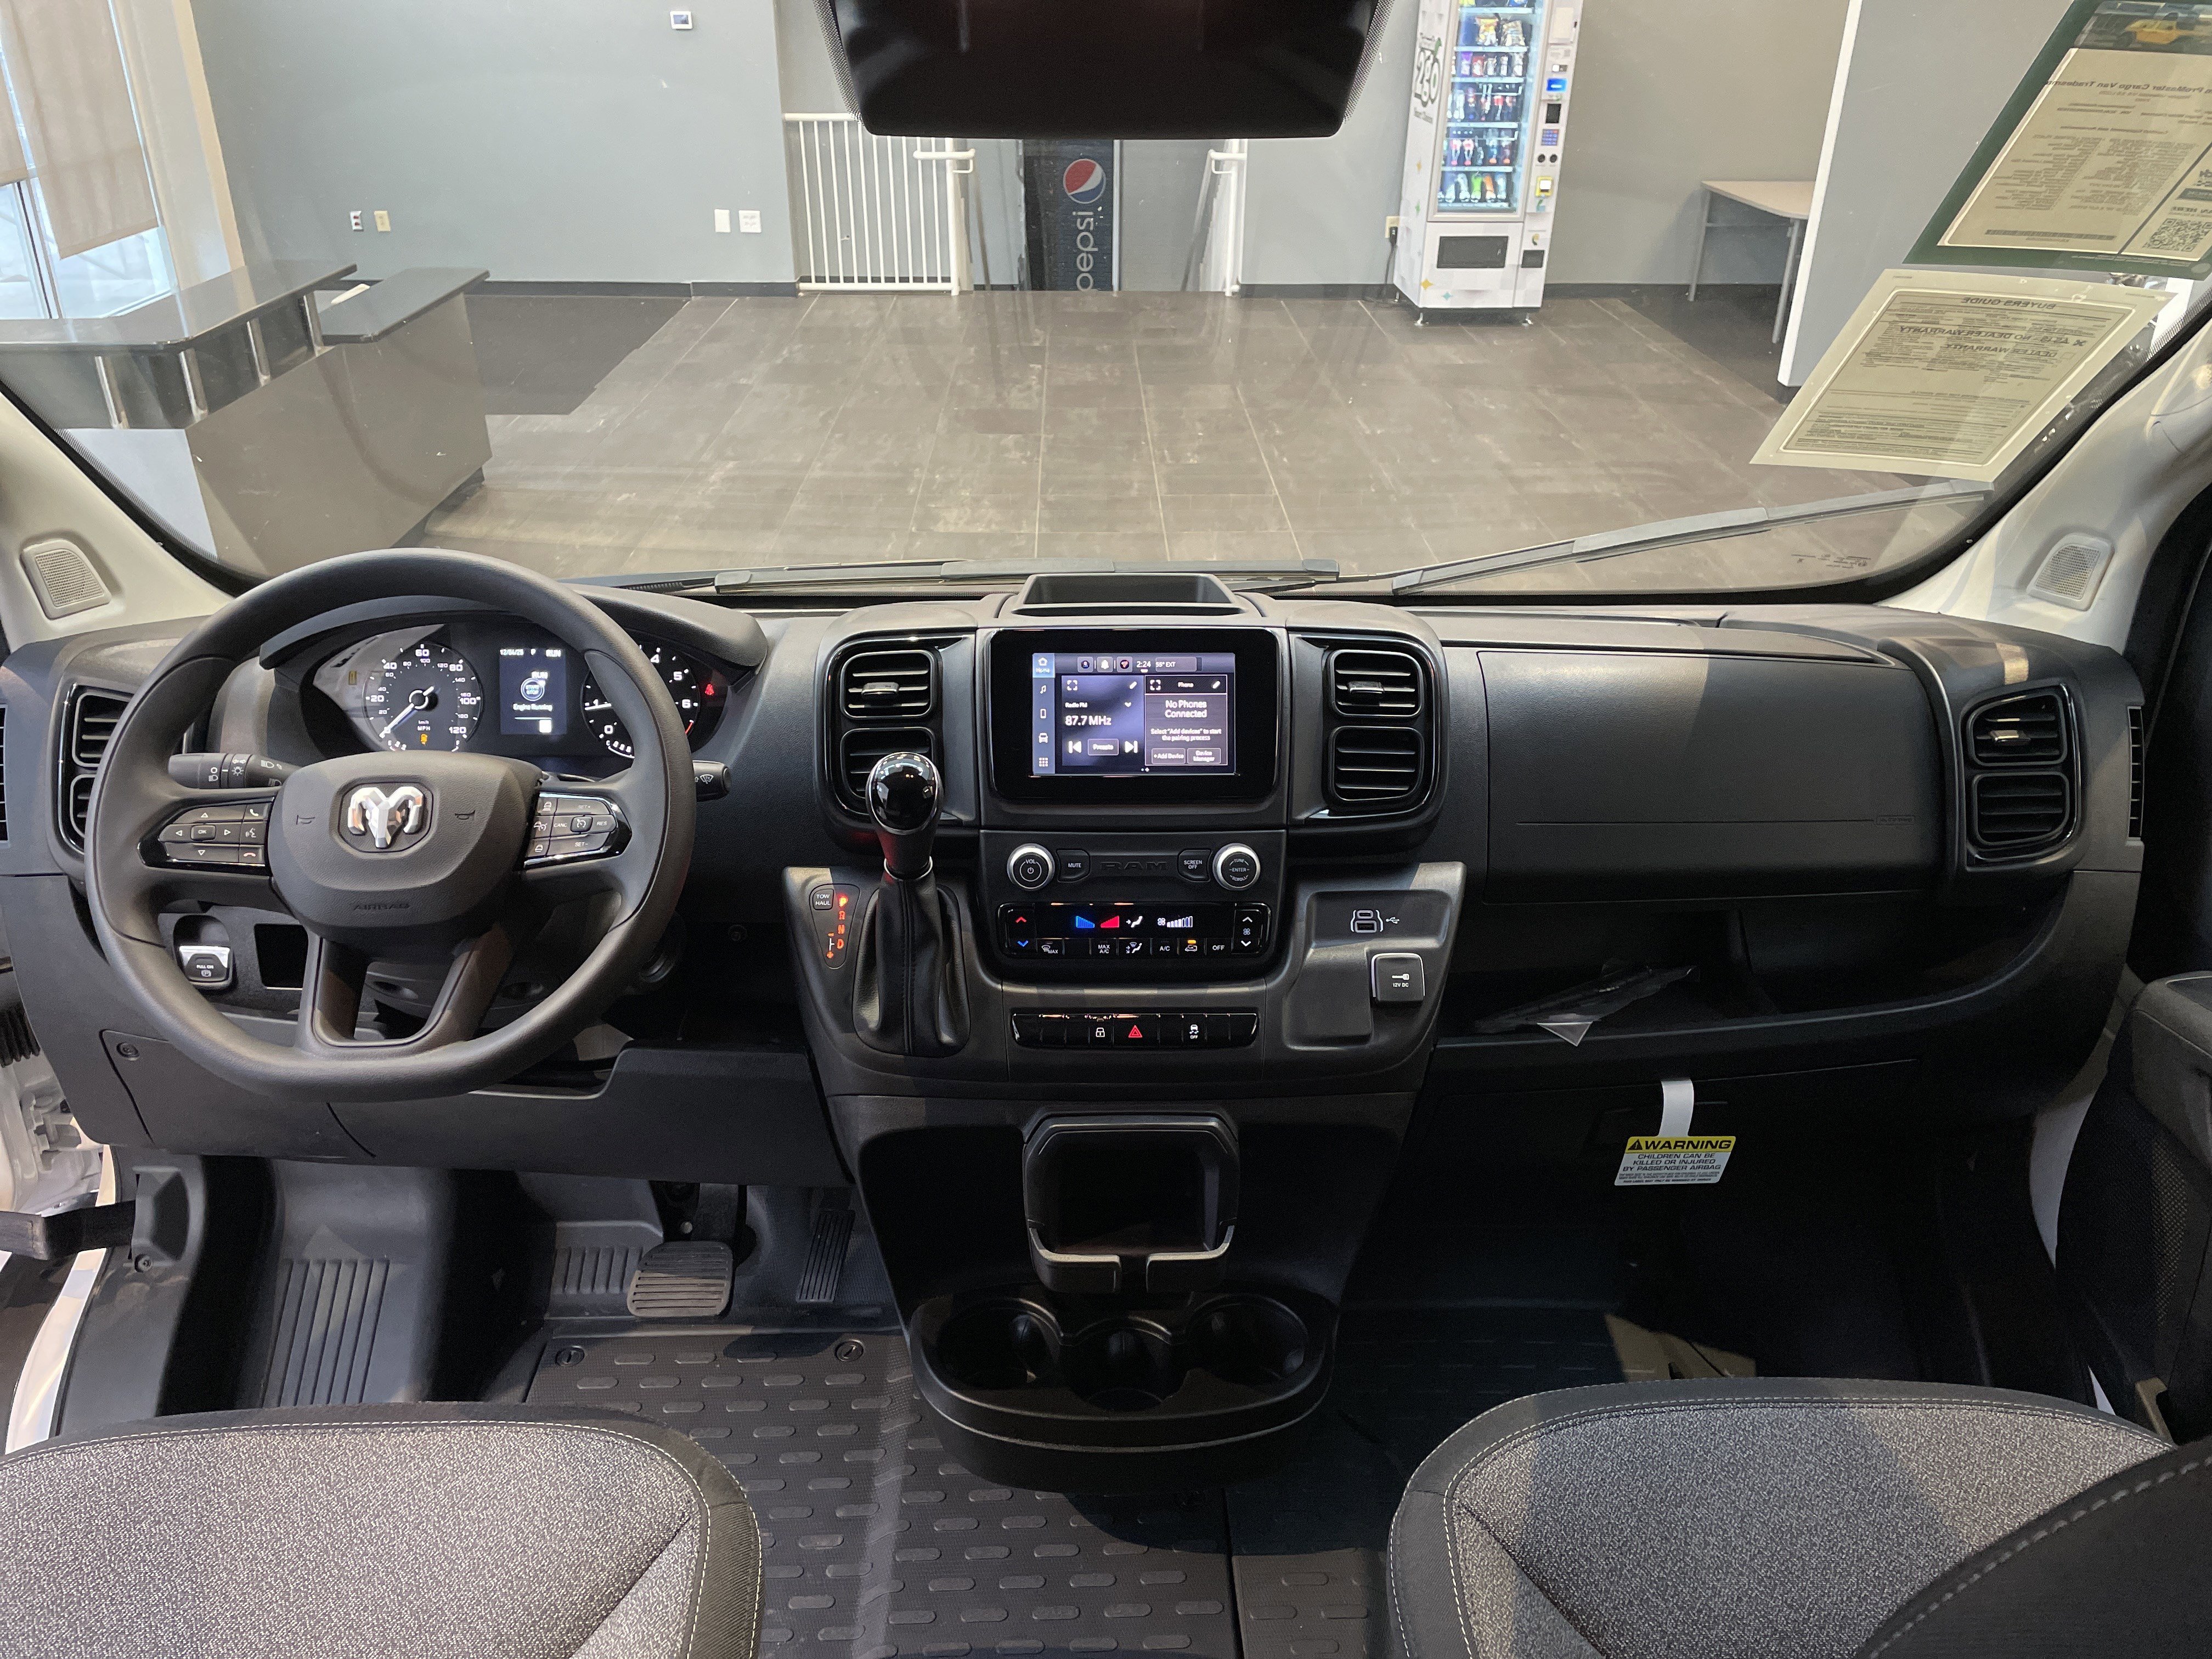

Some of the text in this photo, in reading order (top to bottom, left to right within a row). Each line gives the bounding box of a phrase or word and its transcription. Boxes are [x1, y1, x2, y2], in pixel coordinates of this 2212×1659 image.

[650, 654, 659, 663] 4
[532, 671, 548, 679] RUN
[673, 671, 682, 680] 5
[513, 703, 553, 712] Engine Running
[682, 699, 691, 708] 6
[1165, 699, 1207, 708] No Phones
[1164, 709, 1207, 718] Connected
[1065, 715, 1112, 726] 87.7 MHz
[449, 726, 467, 734] 120
[604, 725, 613, 734] 0
[1100, 861, 1167, 870] RAM
[838, 896, 848, 907] P
[838, 910, 845, 920] R
[837, 924, 845, 934] N
[836, 938, 844, 949] D
[1645, 1139, 1732, 1150] WARNING
